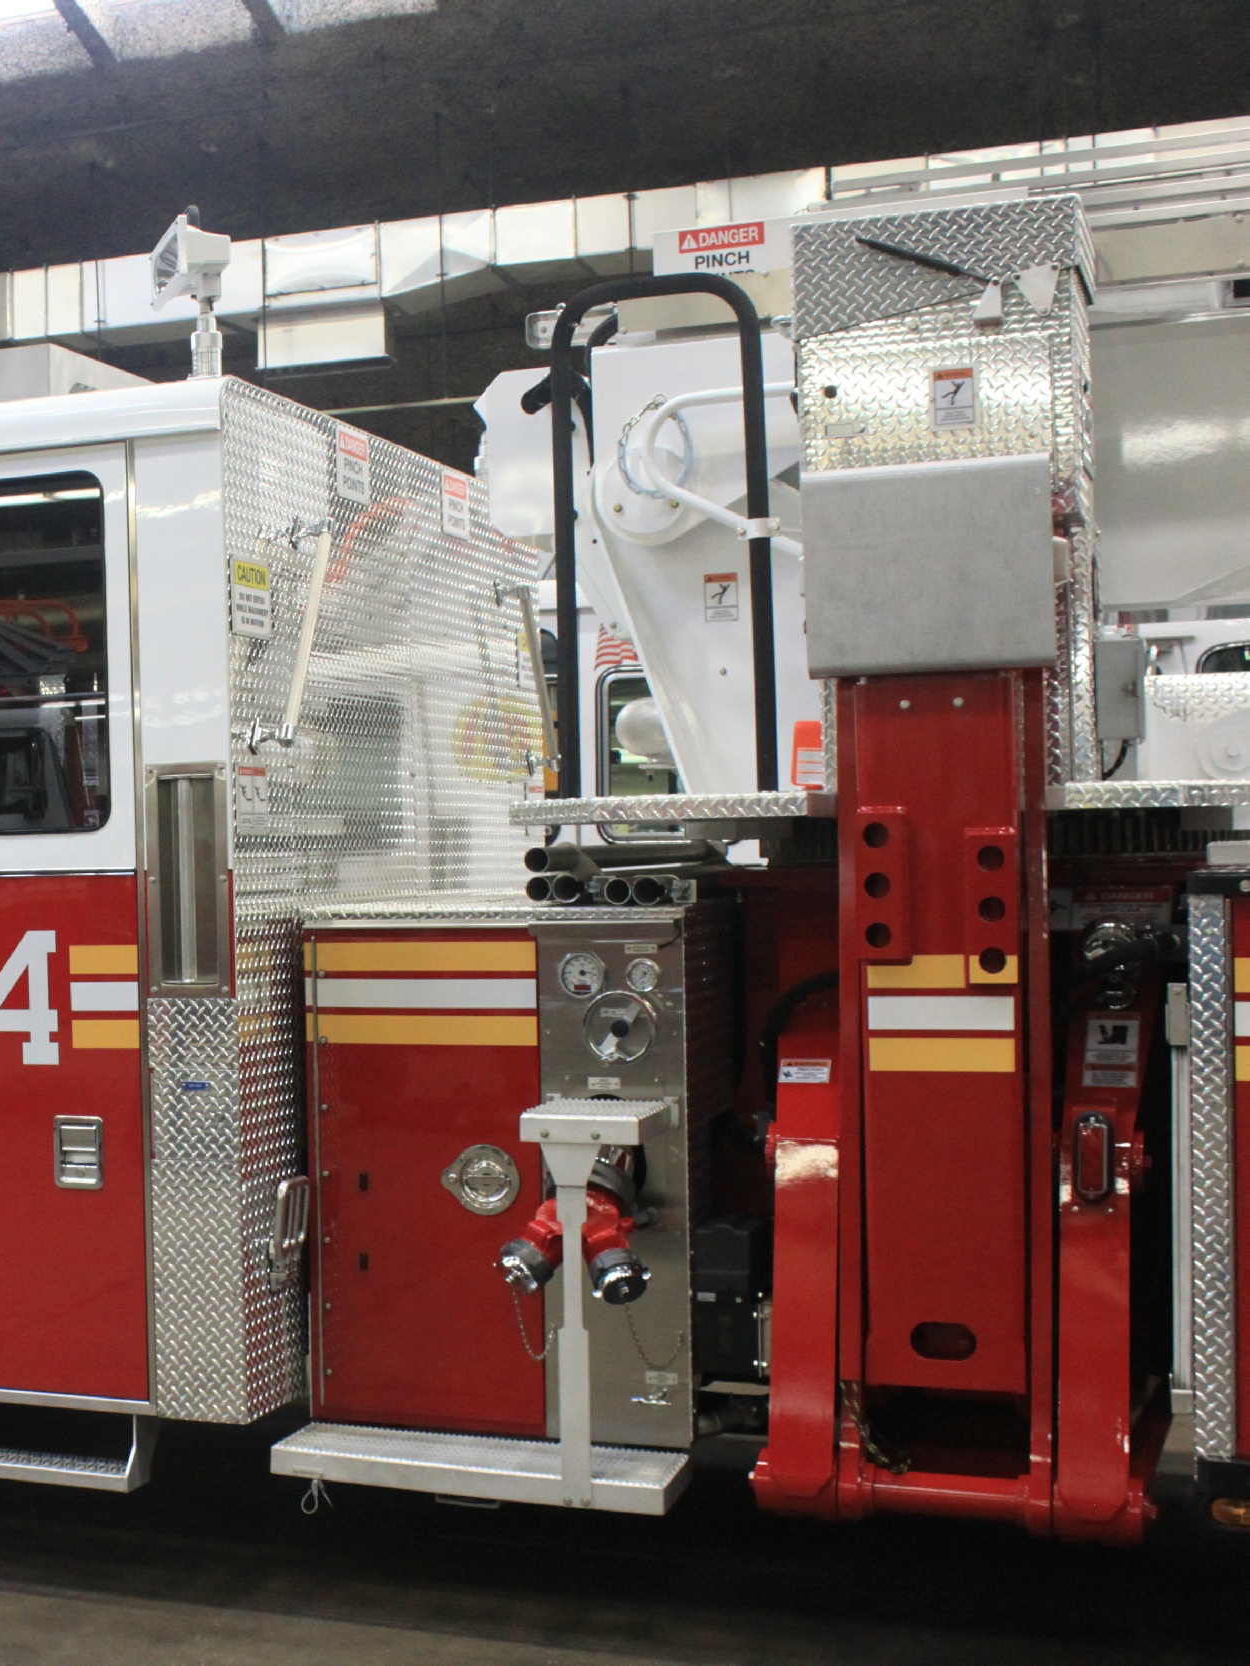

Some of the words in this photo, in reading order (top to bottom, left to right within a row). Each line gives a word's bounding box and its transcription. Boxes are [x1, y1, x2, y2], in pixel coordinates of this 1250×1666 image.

[698, 226, 759, 247] DANGER
[694, 250, 750, 270] PINCH
[344, 436, 366, 457] DANGER
[344, 457, 363, 477] PINCH
[343, 475, 365, 495] POINTS
[237, 564, 267, 587] CAUTION
